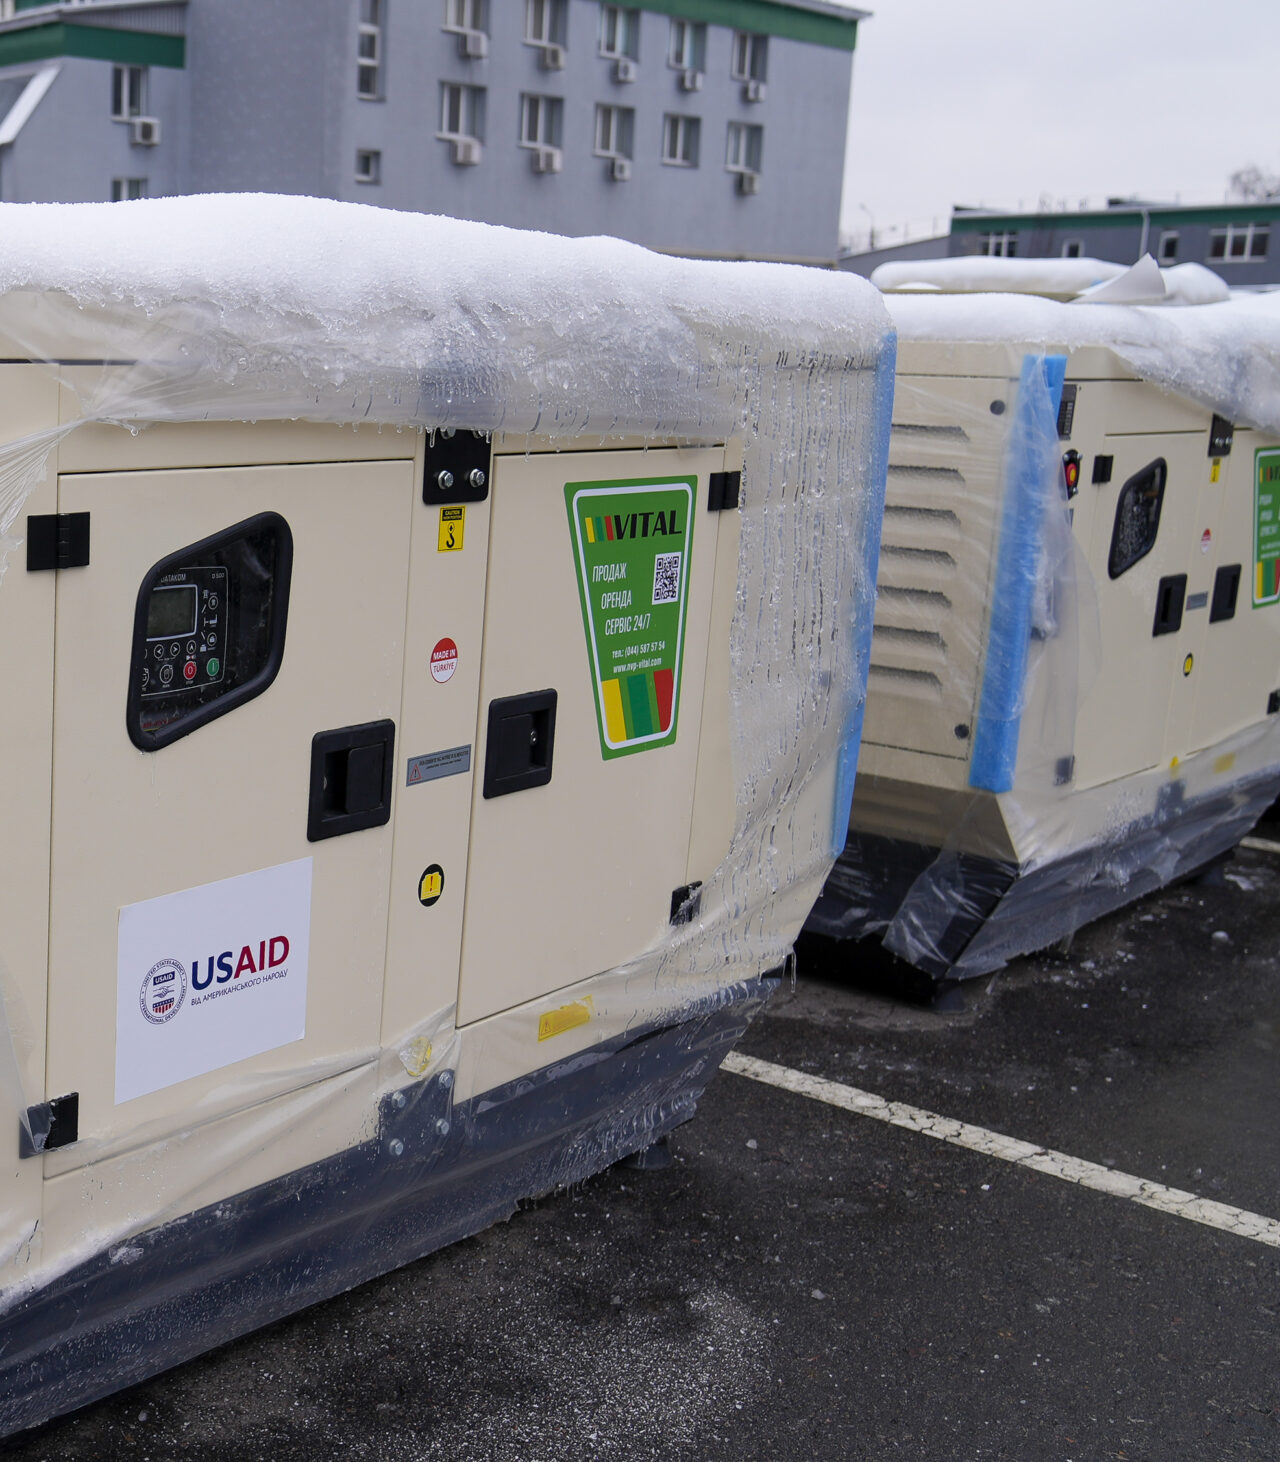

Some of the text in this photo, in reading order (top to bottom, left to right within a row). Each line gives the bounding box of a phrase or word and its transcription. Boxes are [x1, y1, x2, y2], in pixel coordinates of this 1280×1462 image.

[614, 510, 682, 540] VITAL
[592, 562, 627, 583] ПРОДАЖ
[601, 590, 632, 609] ОРЕНДА
[605, 613, 651, 636] СЕРВІС 24/7
[433, 648, 456, 660] MADE IN
[624, 645, 639, 658] (044)
[640, 643, 650, 655] 587
[651, 642, 658, 653] 57
[433, 661, 455, 673] TÜRKİYE
[613, 657, 662, 673] www.nvp-vital.com
[192, 935, 290, 991] USAID
[155, 973, 174, 984] USAID
[191, 968, 289, 1006] ВІД АМЕРИКАНСЬКОГО НАРОДУ
